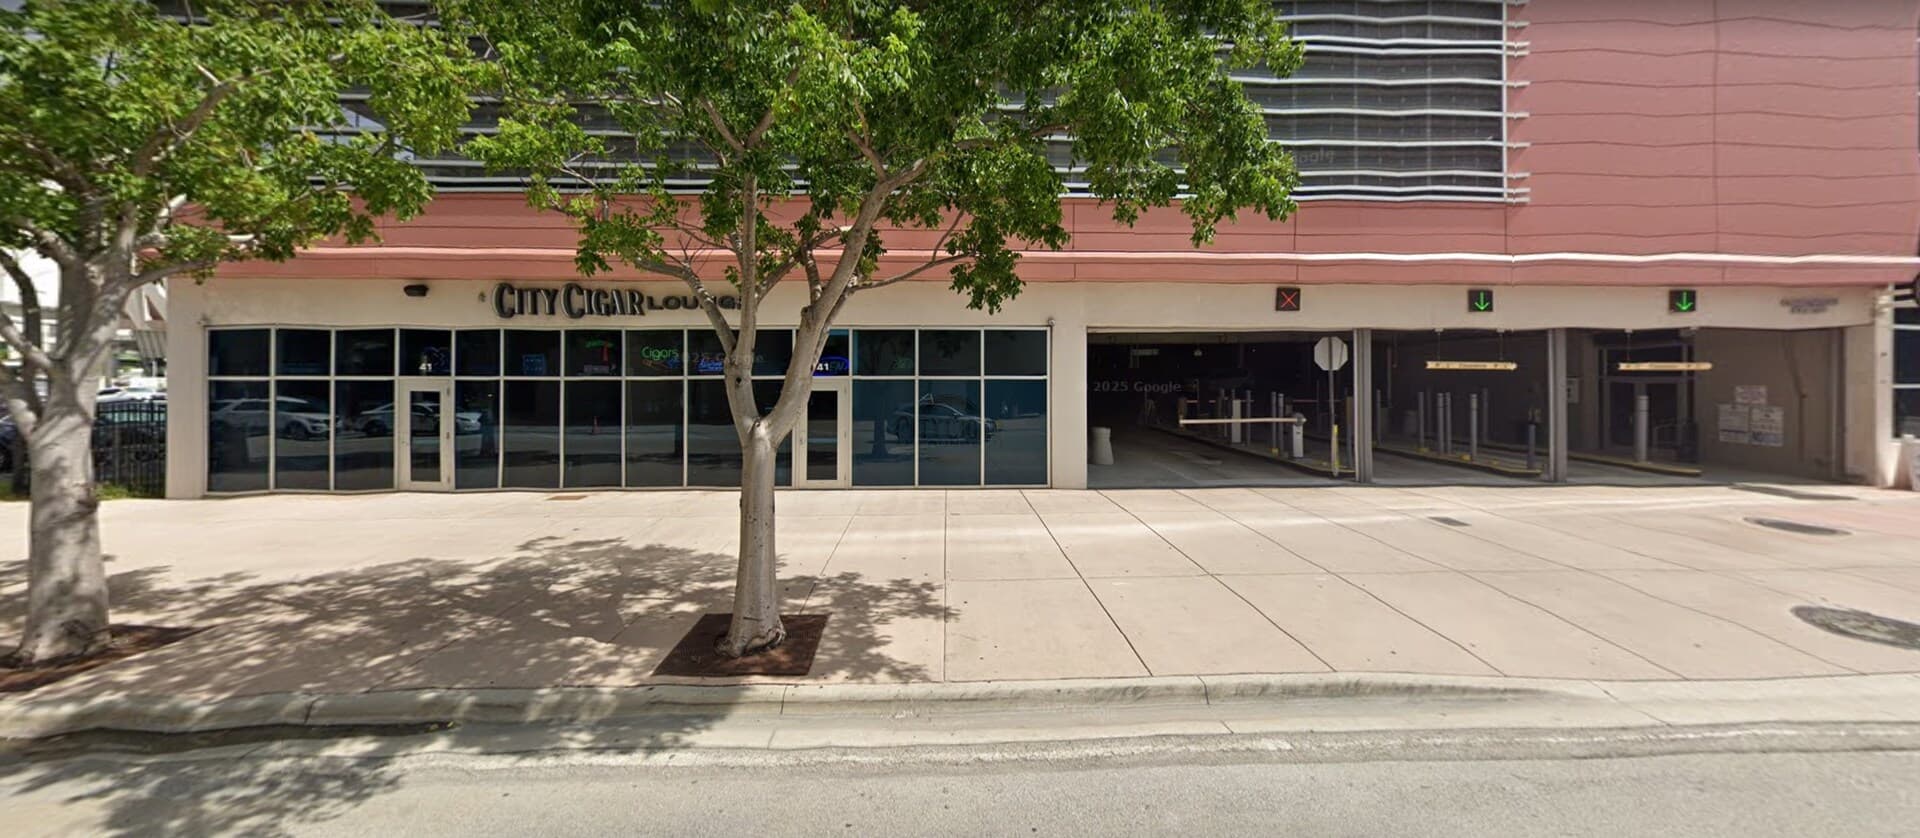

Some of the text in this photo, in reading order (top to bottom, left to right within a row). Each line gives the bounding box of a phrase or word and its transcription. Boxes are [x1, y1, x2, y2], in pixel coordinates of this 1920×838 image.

[493, 282, 558, 318] CITY
[561, 282, 645, 318] CIGAR
[641, 346, 679, 361] Cigars
[816, 362, 829, 371] 41
